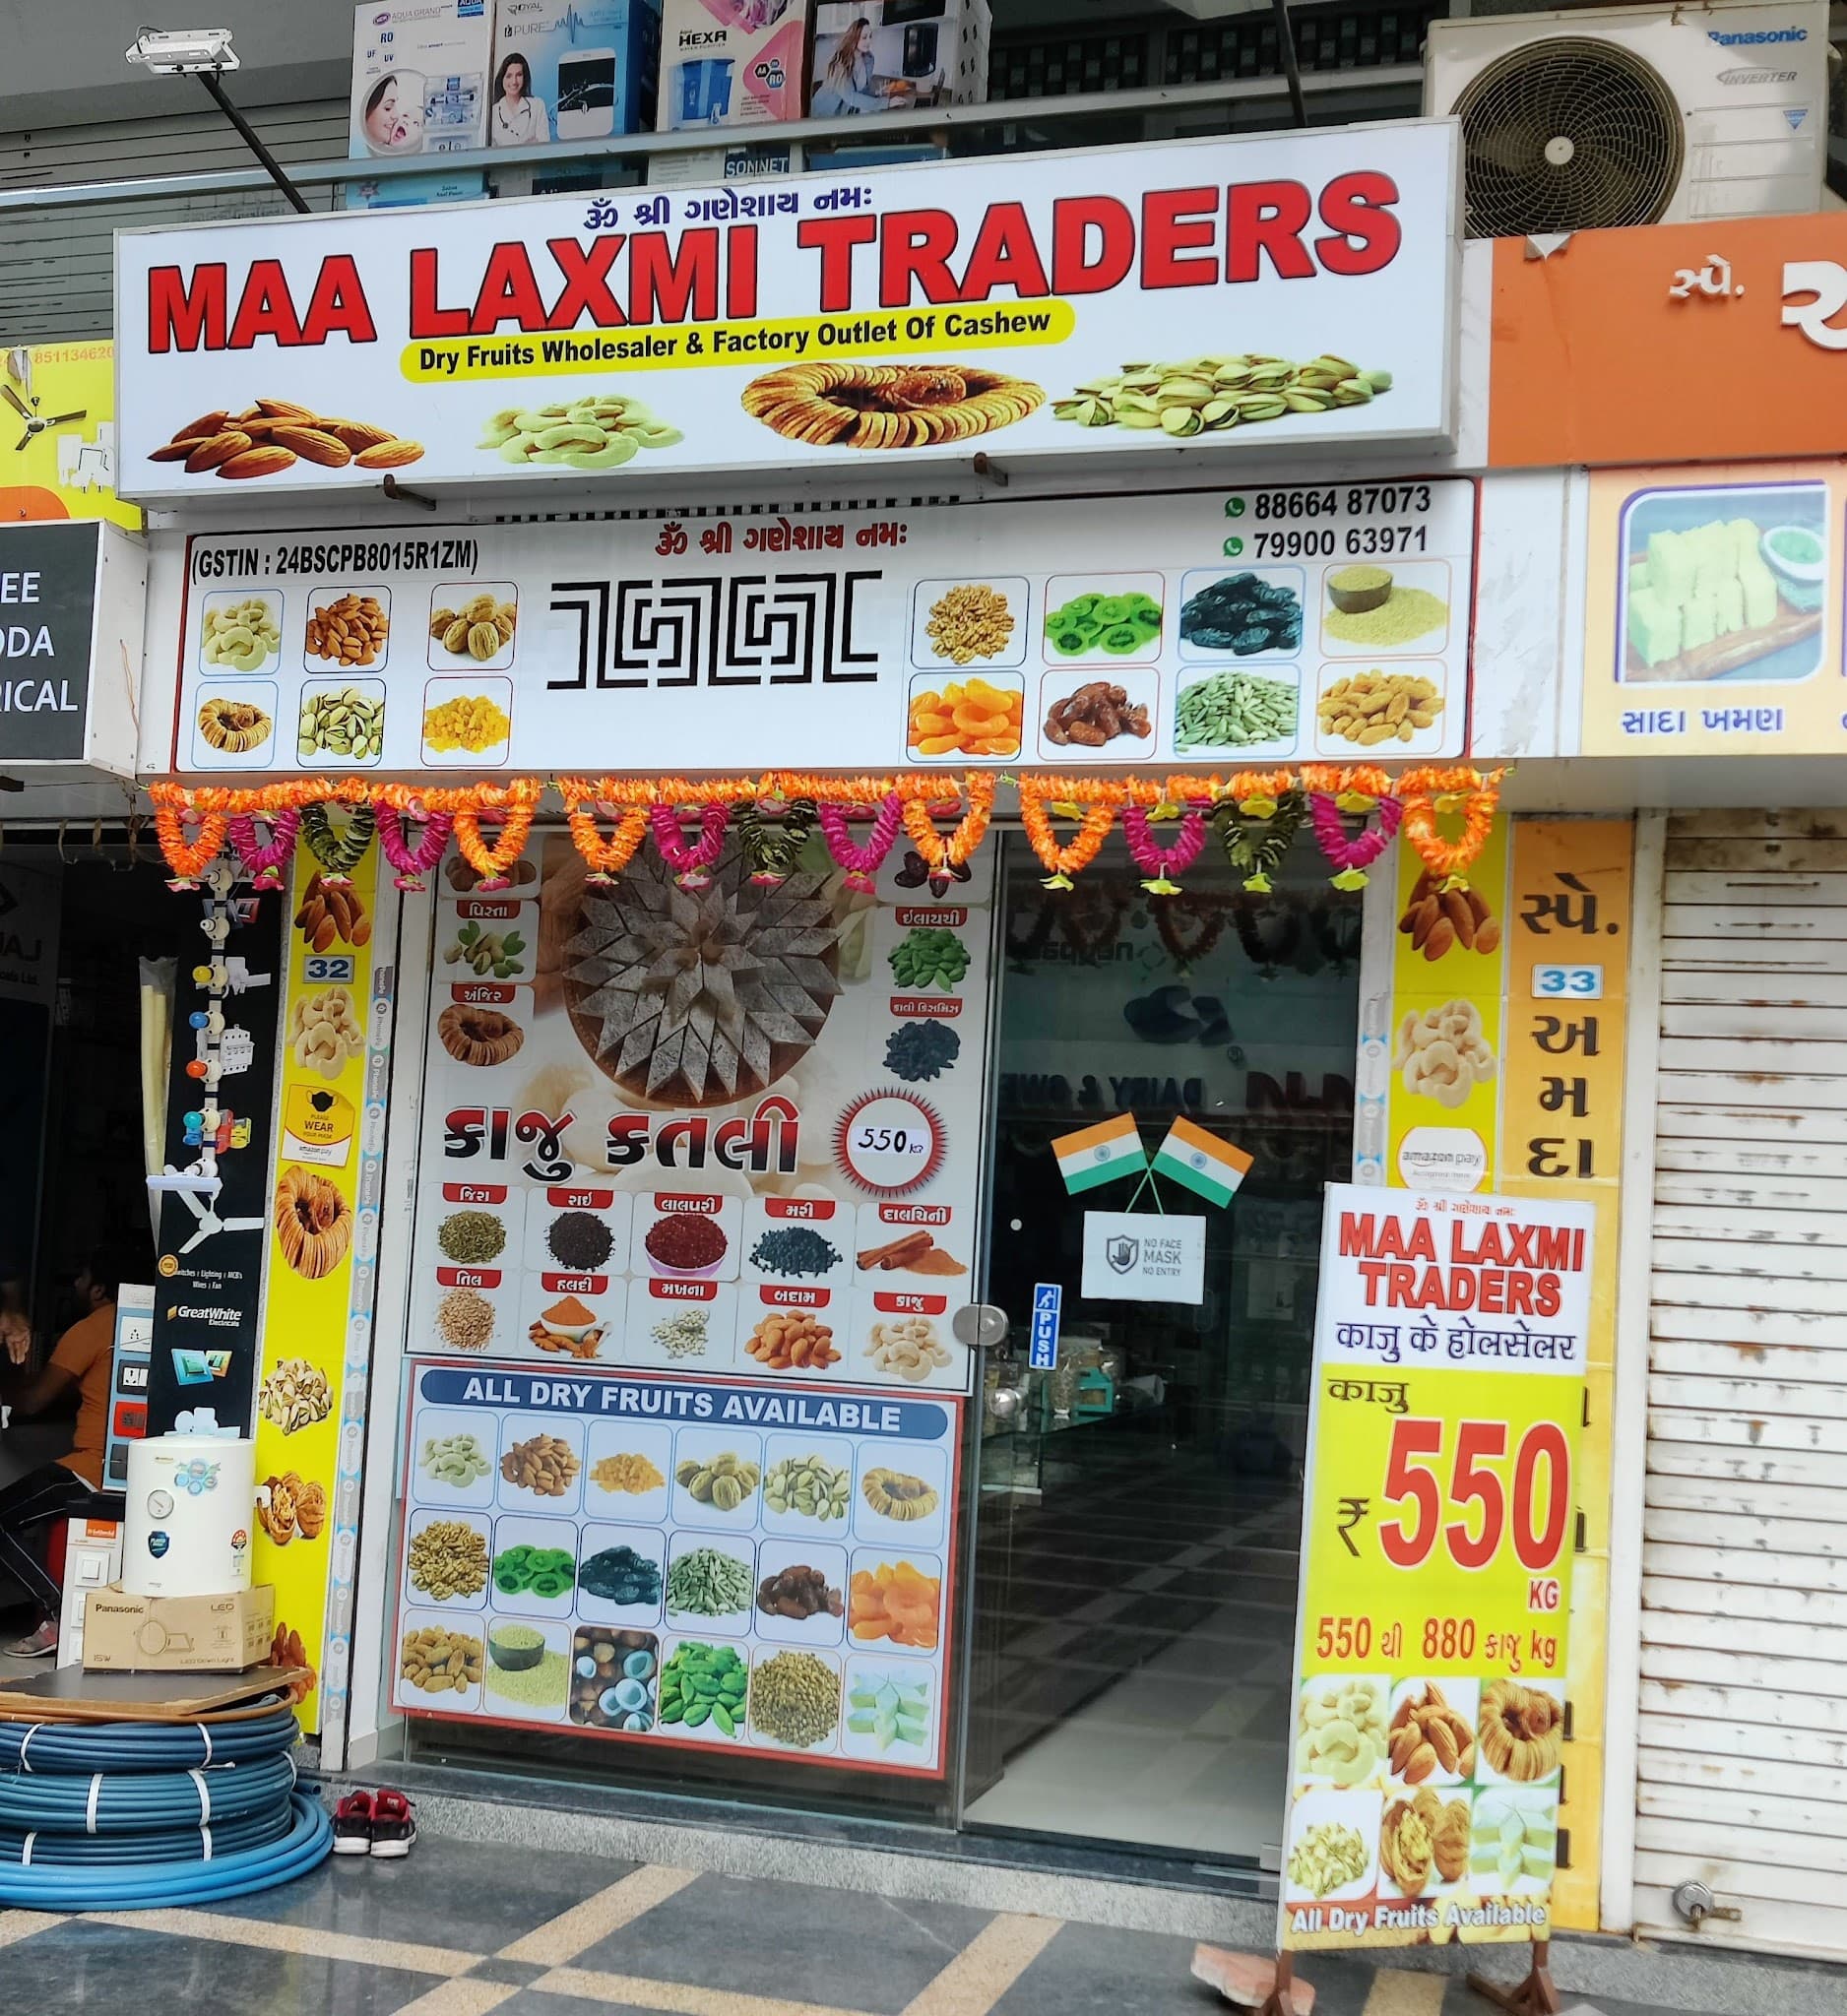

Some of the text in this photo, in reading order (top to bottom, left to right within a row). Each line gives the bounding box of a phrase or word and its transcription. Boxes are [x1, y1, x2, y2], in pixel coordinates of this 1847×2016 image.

[381, 32, 394, 43] RO
[679, 31, 727, 46] HEXA
[1708, 26, 1808, 46] Panasonic
[384, 54, 394, 63] UV
[1723, 69, 1798, 86] INVERTER
[726, 158, 789, 179] SONNET
[633, 196, 670, 226] શ્રી
[684, 187, 799, 221] ગણેશાય
[148, 170, 1402, 354] MAA LAXMI TRADERS
[420, 311, 1051, 375] Dry Fruits Wholesaler & Factory Outlet Of Cashew
[1253, 485, 1432, 520] 88664 87073
[699, 521, 732, 554] શ્રી
[742, 517, 845, 551] ગણેશાય
[1253, 525, 1428, 559] 79900 63971
[192, 547, 259, 587] (GSTIN
[276, 538, 478, 576] 24BSCPB8015R1ZM)
[0, 625, 55, 658] DA
[1623, 708, 1783, 733] સાદા ખમણ
[307, 959, 349, 979] 32
[1541, 970, 1596, 993] 33
[304, 1120, 334, 1132] WEAR
[443, 1094, 800, 1183] કાજુ કતલી
[858, 1128, 907, 1153] 550
[1143, 1238, 1182, 1249] NO FACE
[1339, 1211, 1587, 1272] MAA LAXMI
[1142, 1266, 1181, 1277] NO ENTRY
[1143, 1249, 1181, 1266] MASK
[1359, 1261, 1561, 1317] TRADERS
[178, 1305, 242, 1322] GreatWhite
[1036, 1311, 1051, 1366] PUSH
[1336, 1314, 1578, 1363] काजु के होलसेलर
[463, 1377, 901, 1433] ALL DRY FRUITS AVAILABLE
[1327, 1378, 1410, 1414] काजु
[1378, 1418, 1571, 1572] 550
[96, 1603, 144, 1614] Panasonic
[211, 1603, 235, 1612] LED
[1528, 1580, 1560, 1610] KG
[1316, 1615, 1371, 1660] 550
[1423, 1617, 1476, 1660] 880
[1530, 1629, 1558, 1670] kg
[1291, 1901, 1547, 1937] All Dry Fruits Available
